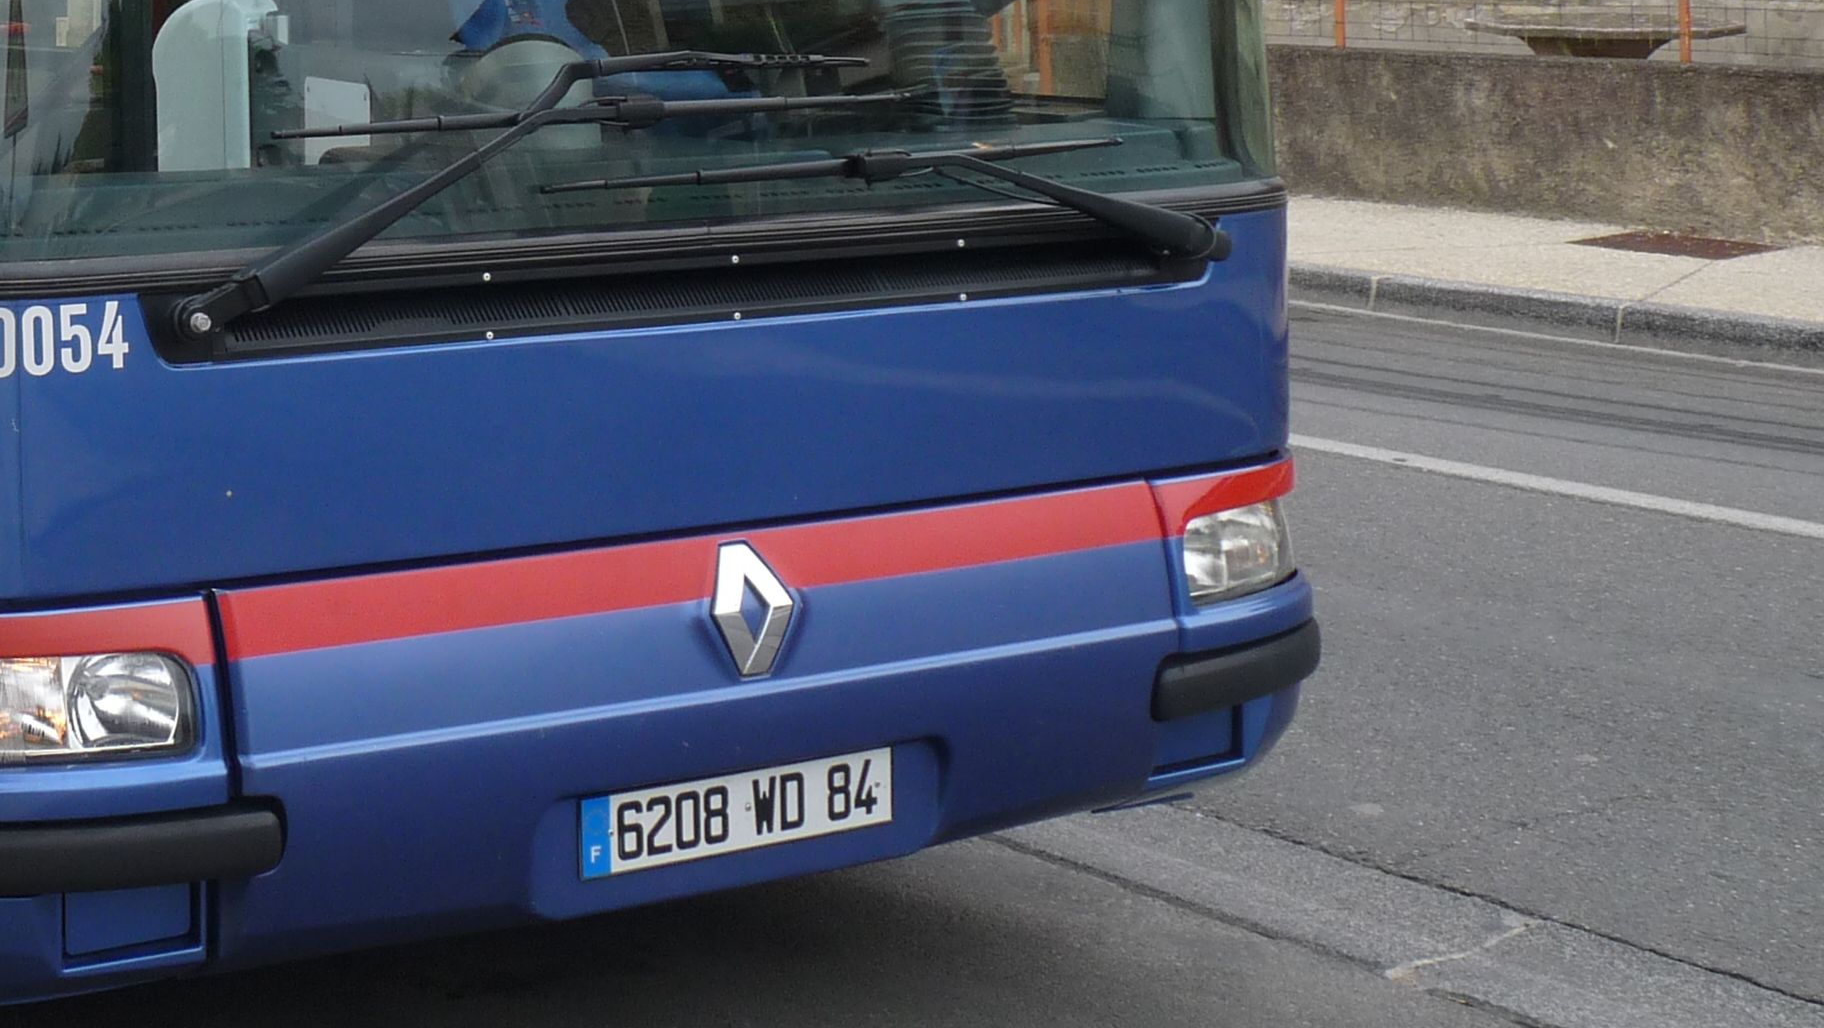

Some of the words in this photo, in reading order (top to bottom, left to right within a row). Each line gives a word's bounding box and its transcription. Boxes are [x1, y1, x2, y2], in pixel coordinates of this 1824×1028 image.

[617, 785, 728, 860] 6208
[752, 772, 805, 835] WD
[827, 759, 877, 822] 84
[590, 845, 602, 863] F
